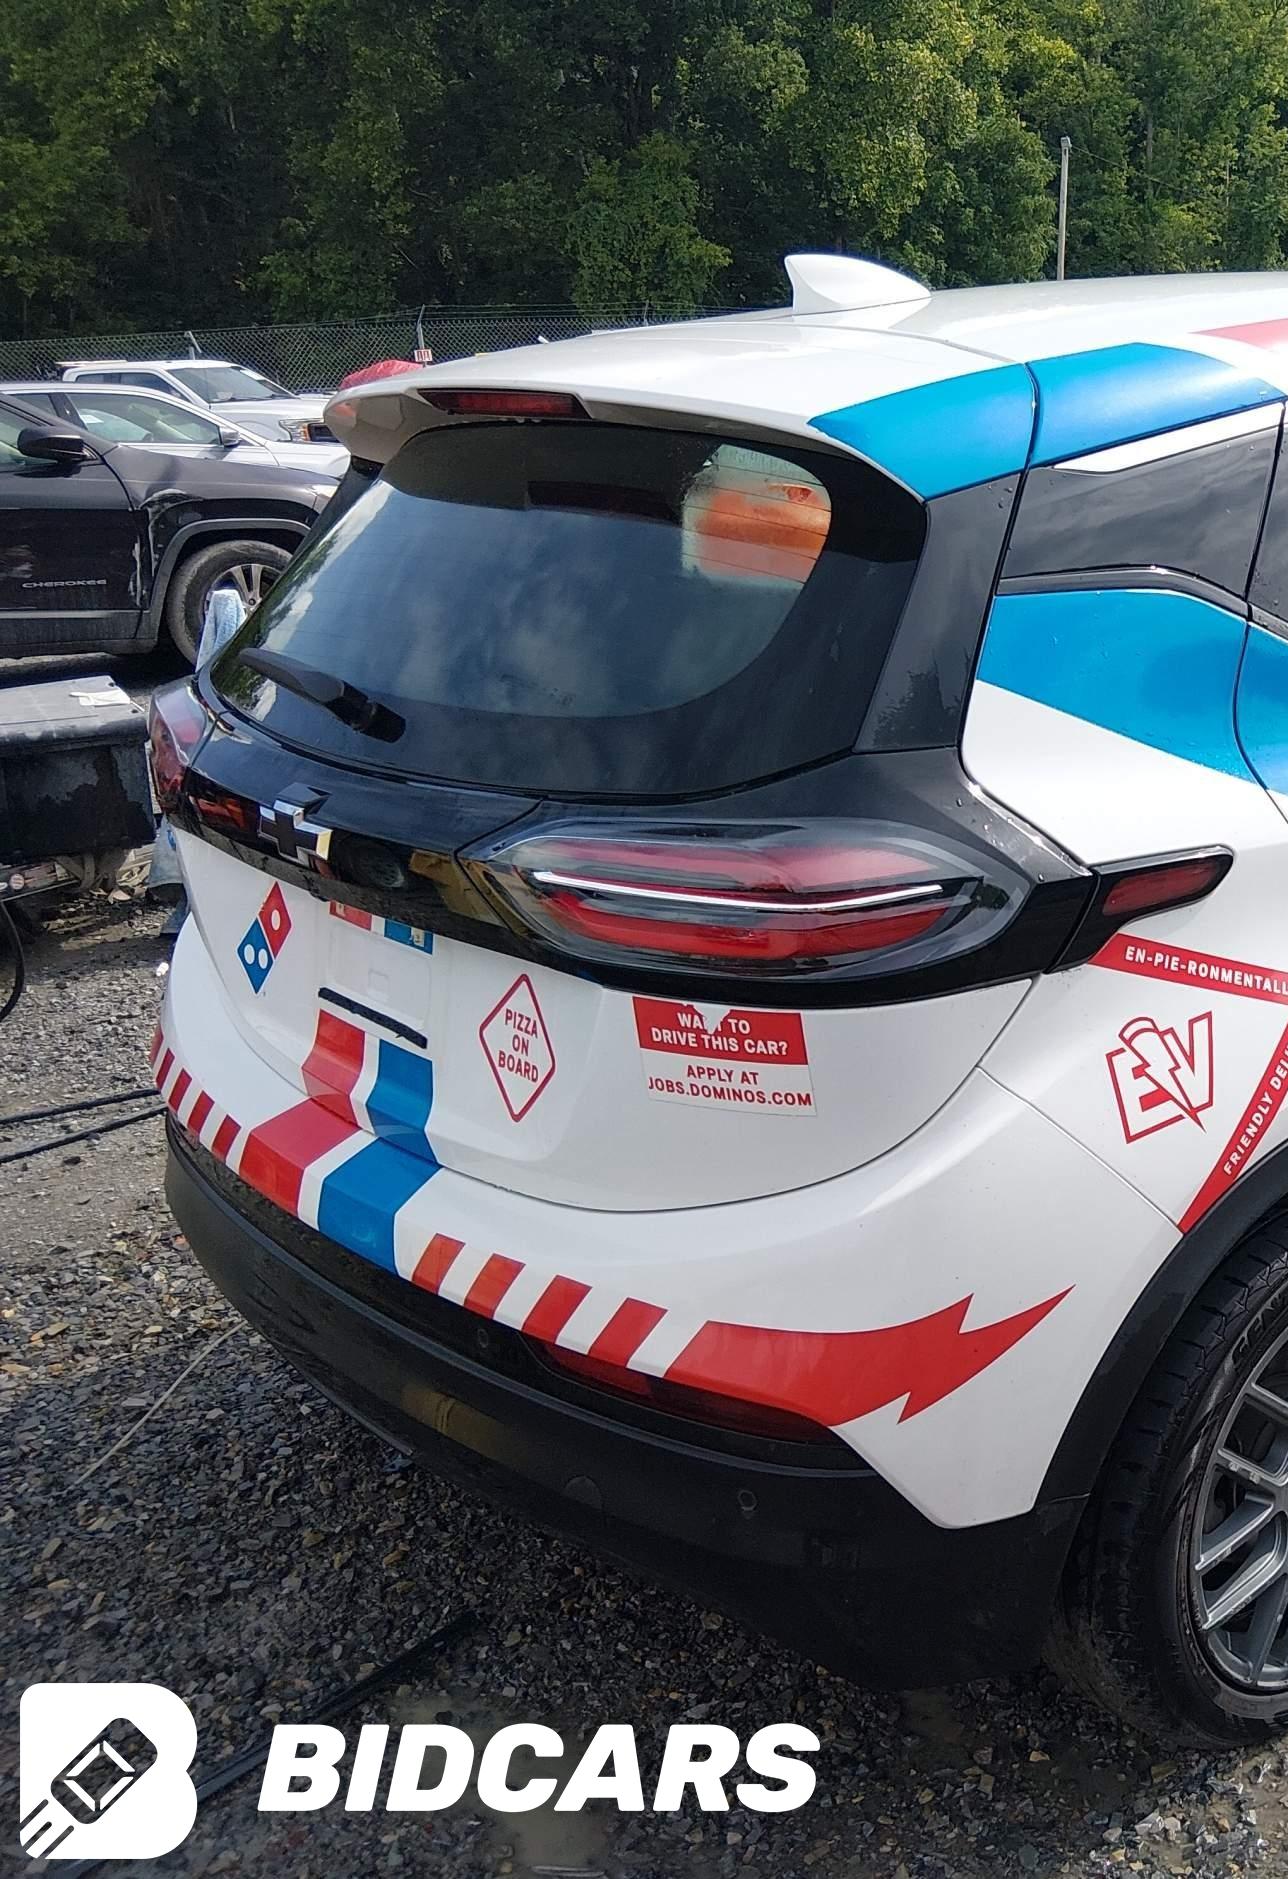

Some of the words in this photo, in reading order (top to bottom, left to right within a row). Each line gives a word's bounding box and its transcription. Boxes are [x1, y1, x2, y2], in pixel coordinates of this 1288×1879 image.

[22, 579, 106, 588] CHEROKEE
[505, 1008, 538, 1039] PIZZA
[727, 1018, 751, 1035] TO
[512, 1034, 529, 1057] ON
[651, 1027, 698, 1048] DRIVE
[701, 1034, 739, 1052] THIS
[744, 1039, 788, 1056] CAR?
[498, 1049, 539, 1083] BOARD
[687, 1064, 734, 1083] APPLY
[740, 1071, 759, 1086] AT
[648, 1077, 812, 1106] JOBS.DOMINOS.COM
[1223, 1094, 1273, 1176] FRIENDLY
